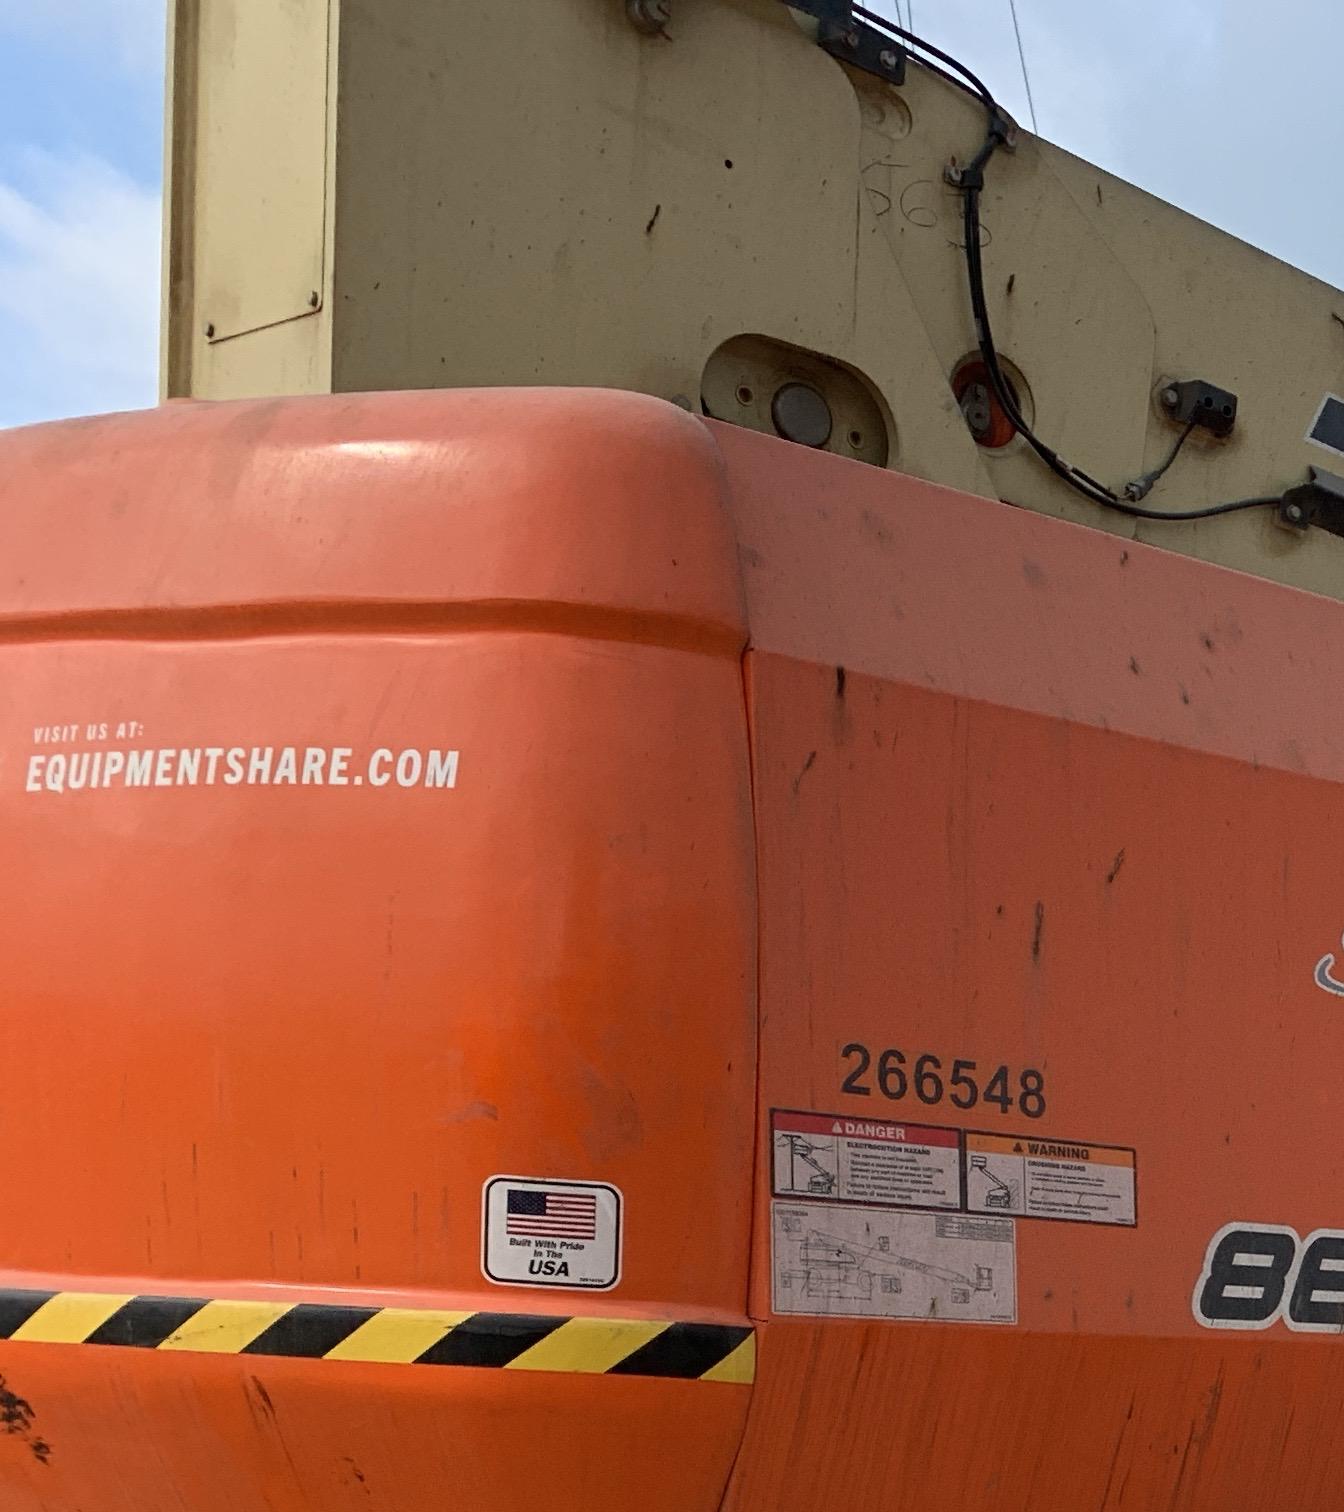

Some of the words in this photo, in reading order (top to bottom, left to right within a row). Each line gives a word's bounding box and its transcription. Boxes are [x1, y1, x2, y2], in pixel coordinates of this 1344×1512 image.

[33, 725, 79, 744] VISIT
[86, 723, 108, 741] US
[116, 721, 145, 740] AT:
[25, 747, 460, 794] EQUIPMENTSHARE.COM
[839, 1042, 1048, 1119] 266548
[845, 1121, 906, 1141] DANGER
[1027, 1142, 1090, 1160] WARNING
[509, 1237, 531, 1247] Built
[535, 1239, 557, 1250] With
[560, 1241, 585, 1251] Pride
[533, 1249, 543, 1258] In
[545, 1249, 563, 1259] The
[528, 1259, 569, 1277] USA
